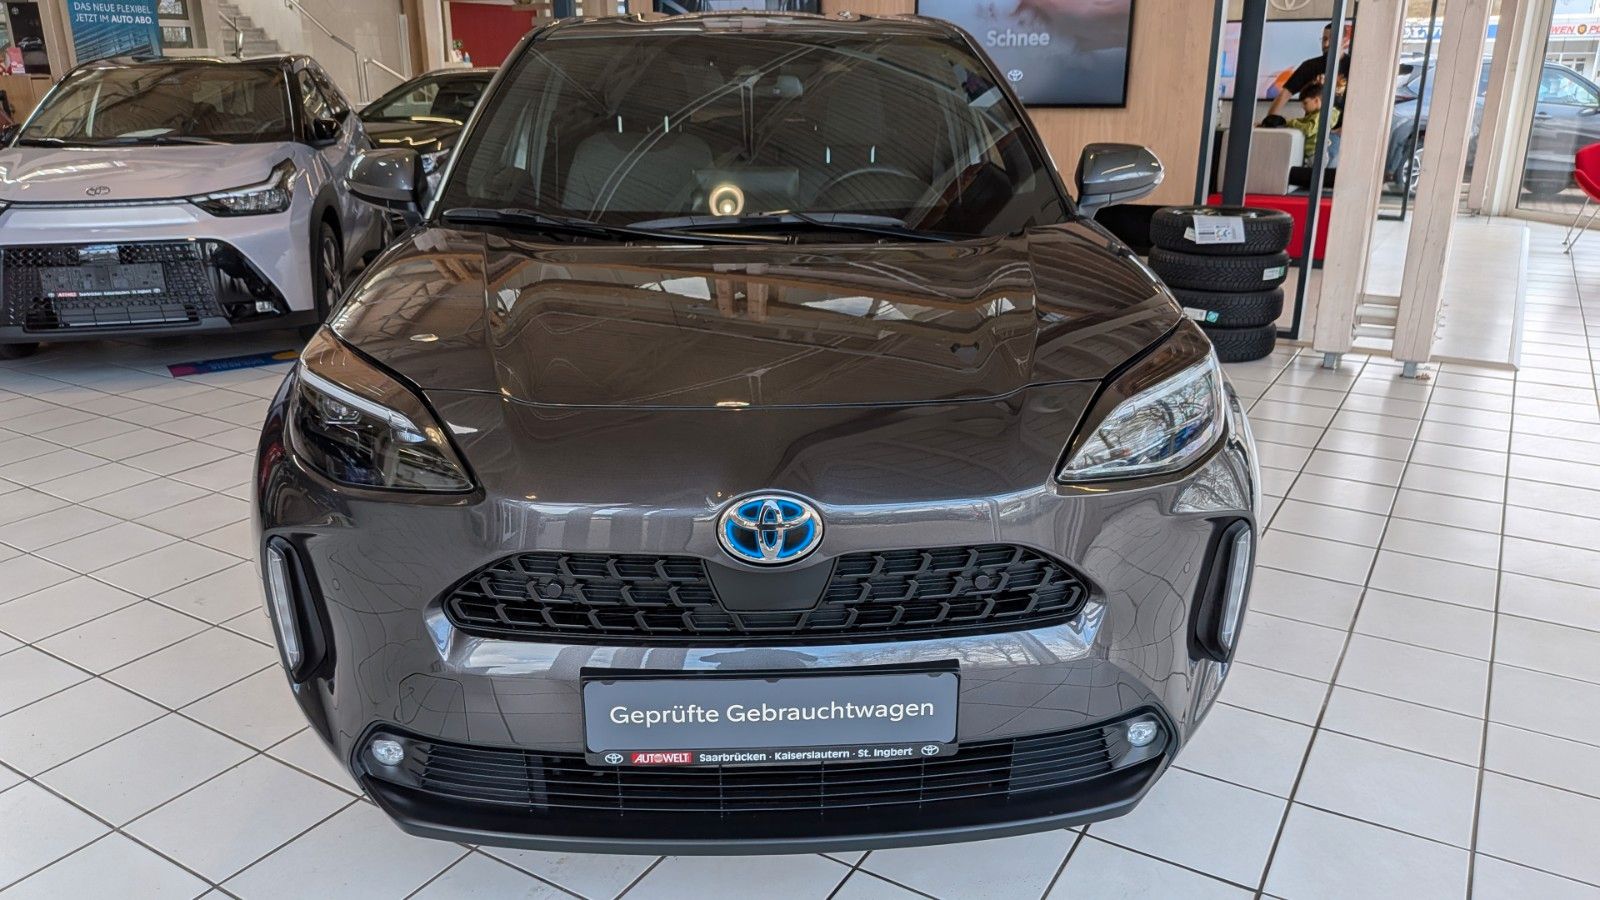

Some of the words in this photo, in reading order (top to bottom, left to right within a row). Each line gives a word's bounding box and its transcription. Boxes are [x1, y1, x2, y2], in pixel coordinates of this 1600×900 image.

[74, 2, 91, 11] DAS
[93, 3, 115, 12] NEUE
[75, 13, 98, 22] JETZT
[100, 14, 109, 23] IM
[111, 15, 133, 23] AUTO
[135, 16, 154, 24] ABO.
[987, 28, 1050, 47] Schnee
[610, 704, 719, 728] Geprüfte
[726, 701, 934, 723] Gebrauchtwagen
[633, 753, 691, 763] AUTOWELT
[699, 752, 767, 762] Saarbrücken
[774, 751, 850, 760] Kaiserslautern
[857, 749, 872, 758] St.
[873, 747, 913, 758] Ingbert
